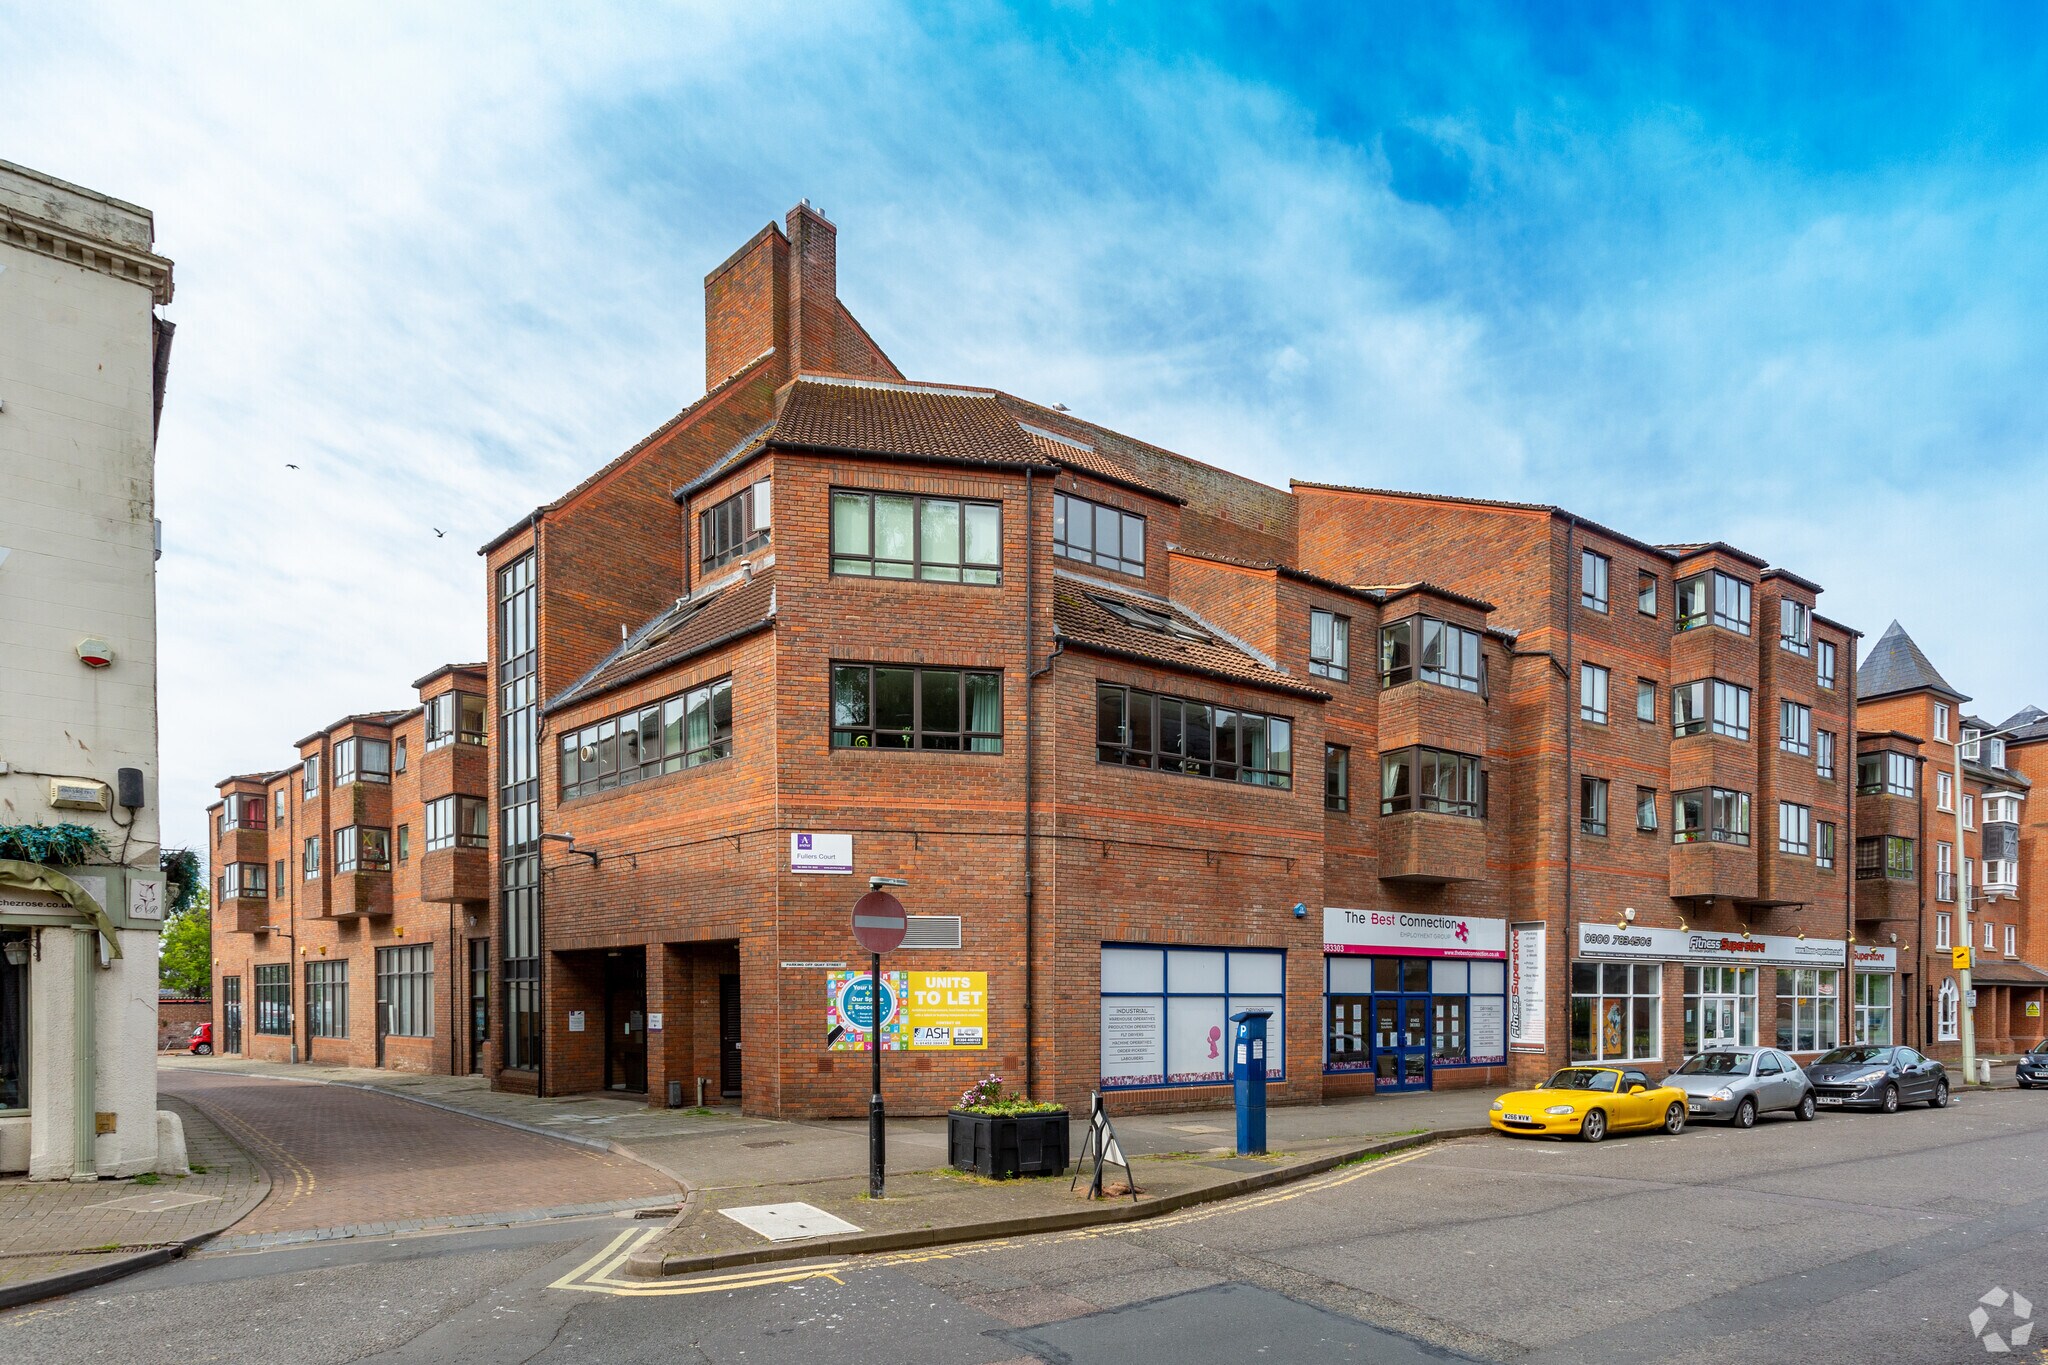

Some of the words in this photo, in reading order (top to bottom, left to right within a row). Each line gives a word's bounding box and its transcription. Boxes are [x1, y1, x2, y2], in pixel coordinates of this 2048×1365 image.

[1345, 911, 1366, 925] The
[1371, 913, 1395, 926] Best
[1400, 915, 1457, 930] Connection
[1584, 933, 1611, 945] 0800
[1612, 934, 1652, 947] 7834506
[926, 976, 970, 989] UNITS
[914, 990, 941, 1005] TO
[947, 991, 983, 1005] LET
[925, 1027, 950, 1039] ASH
[1240, 1024, 1247, 1038] P
